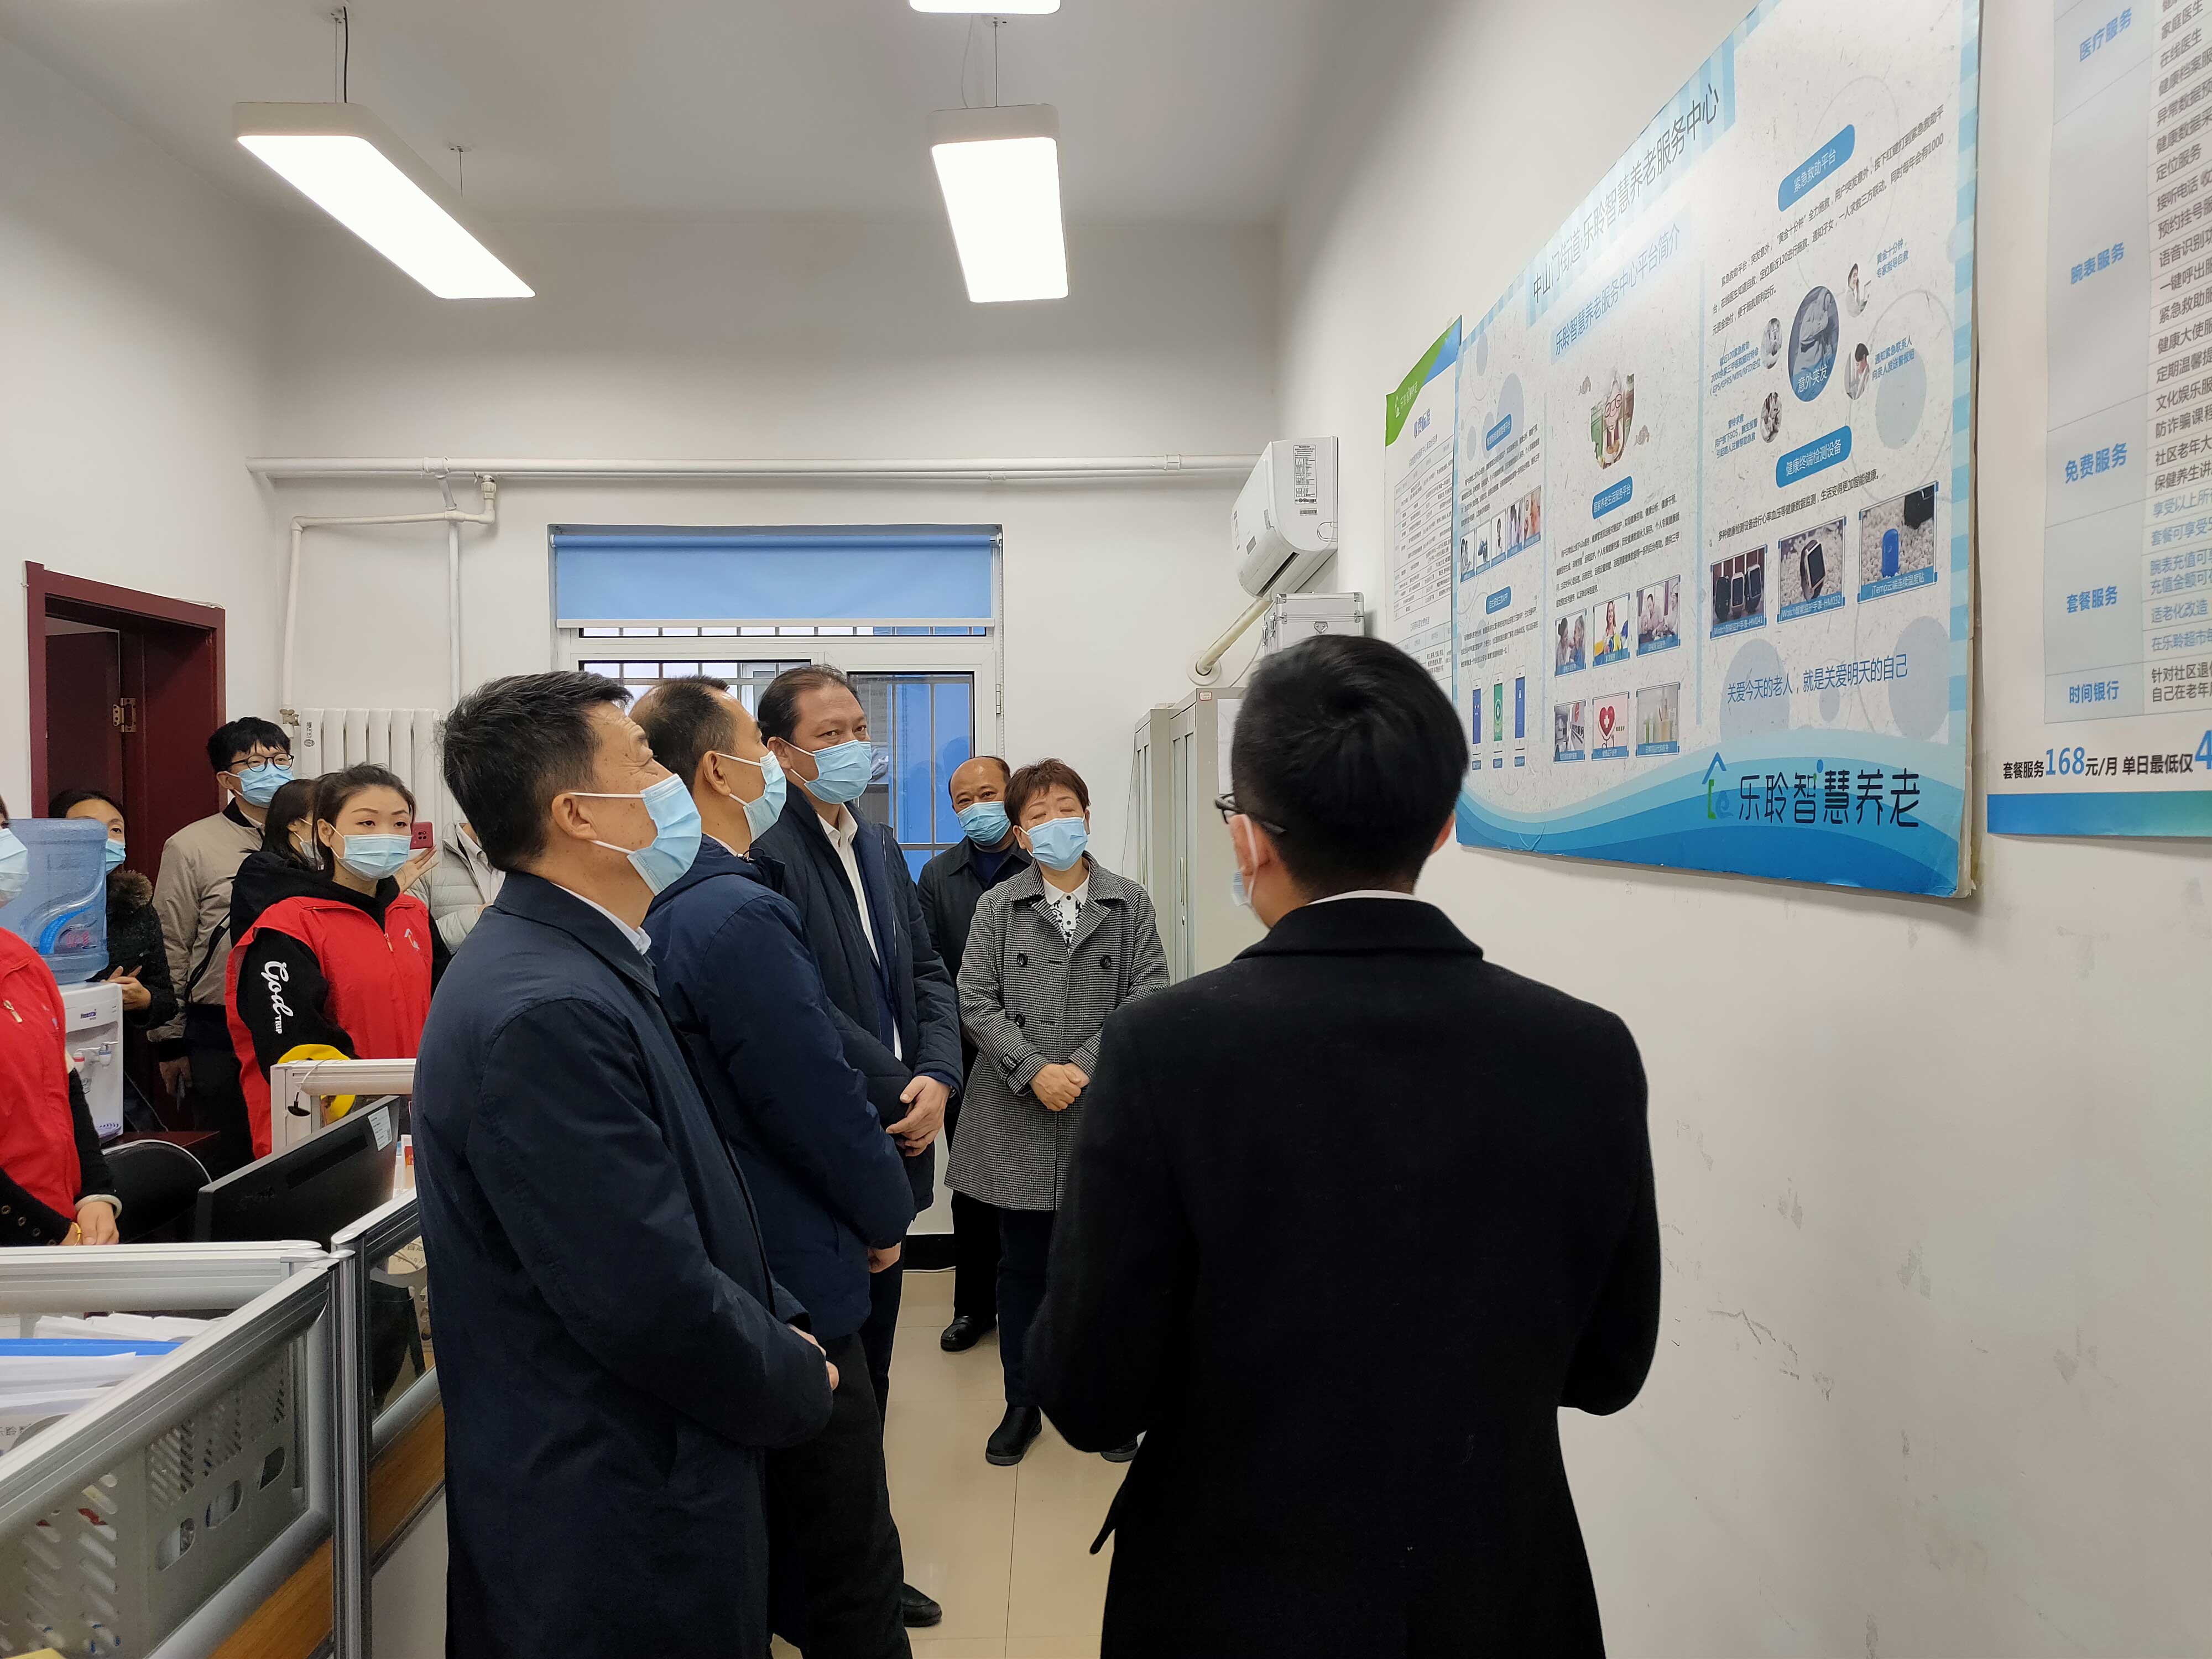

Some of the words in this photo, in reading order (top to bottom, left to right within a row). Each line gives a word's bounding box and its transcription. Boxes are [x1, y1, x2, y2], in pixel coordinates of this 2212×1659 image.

[2079, 8, 2132, 62] 医疗服务
[2161, 0, 2203, 40] 家庭医生
[2160, 28, 2202, 69] 在线医生
[1793, 148, 1837, 194] 紧急救助平台
[2156, 143, 2201, 183] 定位服务
[2157, 175, 2199, 212] 接听电话
[2070, 242, 2125, 285] 腕表服务
[1556, 223, 1679, 356] 乐聆智慧养老服务中心平台简介
[1798, 365, 1828, 394] 意外突发
[1786, 439, 1842, 477] 健康终端检测设备
[2064, 442, 2128, 484] 免费服务
[2156, 434, 2212, 467] 社区老年大
[2153, 487, 2212, 518] 享受以上所
[2067, 585, 2117, 614] 套餐服务
[2151, 599, 2208, 624] 适老化改造
[1727, 653, 1908, 704] 关爱今天的老人，就是关爱明天的自己
[2069, 680, 2119, 704] 时间银行
[2152, 681, 2212, 703] 自己在老年
[1739, 768, 1921, 828] 乐聆智慧养老
